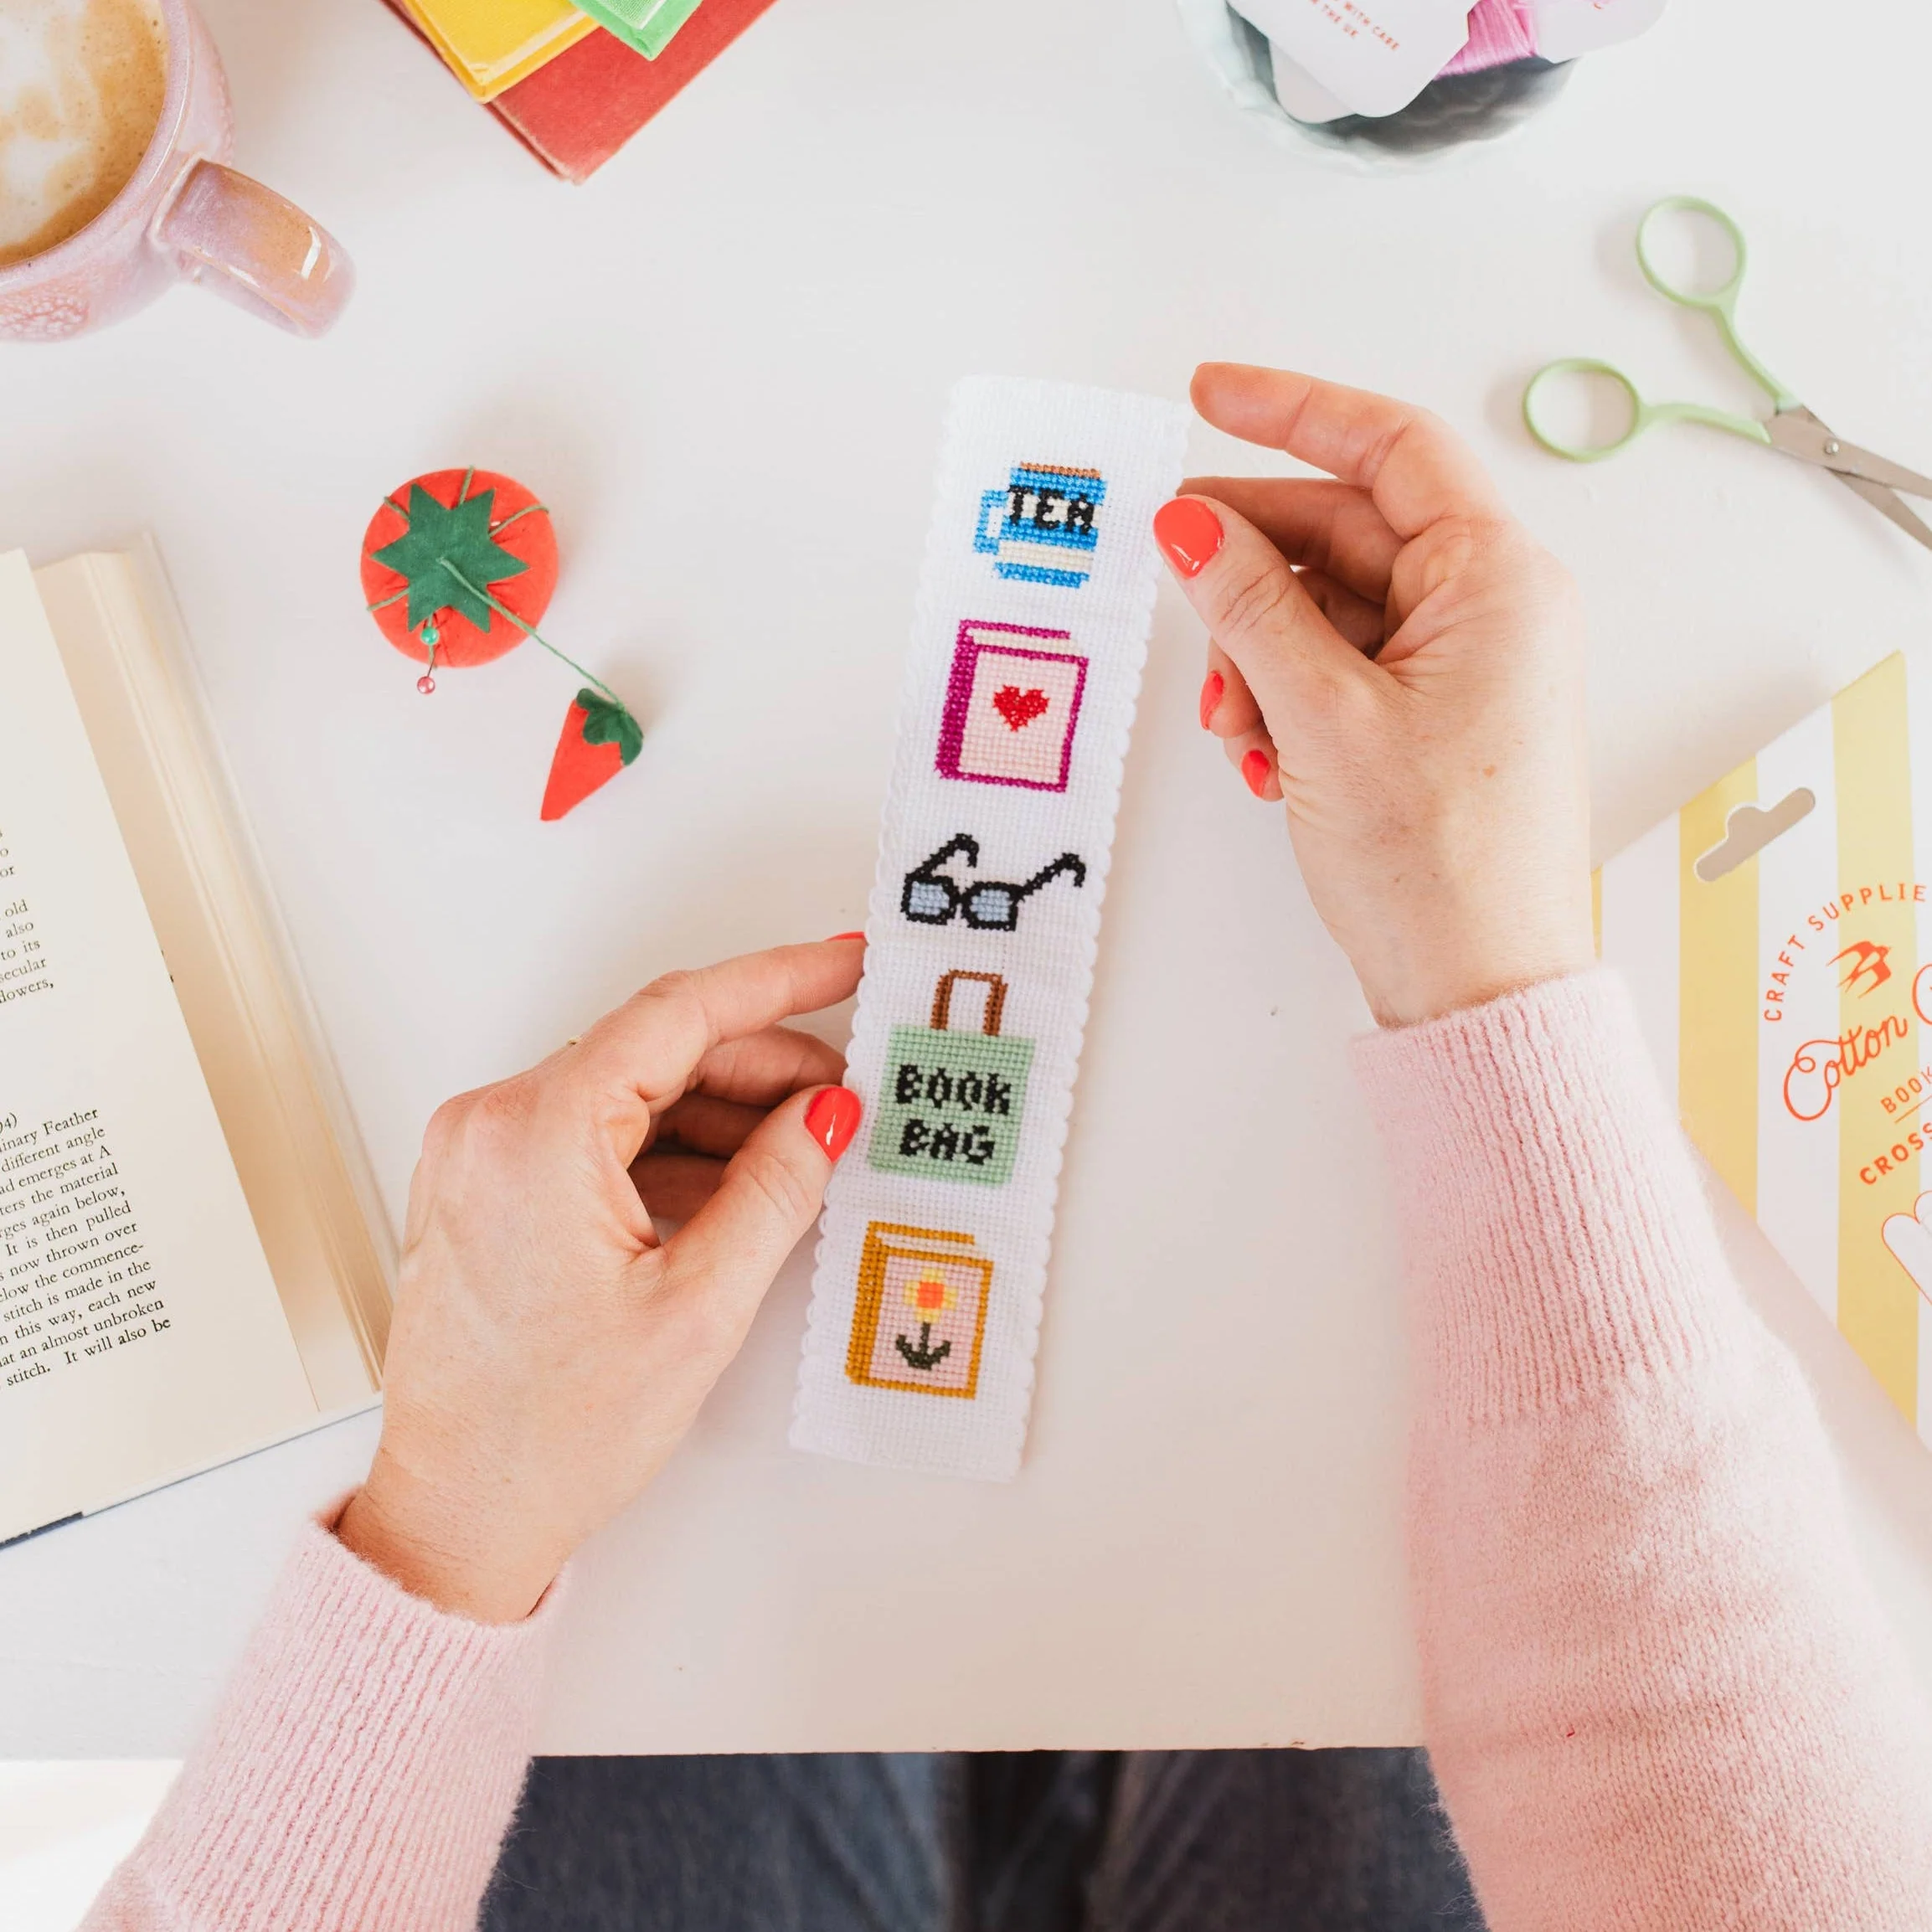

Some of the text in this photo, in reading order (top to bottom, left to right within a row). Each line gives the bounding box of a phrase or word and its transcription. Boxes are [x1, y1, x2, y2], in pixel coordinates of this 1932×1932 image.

[1007, 484, 1094, 534] TEA
[5, 899, 28, 917] old
[6, 922, 34, 939] also
[22, 940, 40, 953] its
[1764, 934, 1806, 1022] CRAFT
[895, 1064, 1012, 1116] BOOK
[1783, 1014, 1909, 1121] Cotton
[43, 1108, 99, 1136] Feather
[899, 1118, 995, 1166] BAG
[1, 1127, 106, 1172] different angle
[18, 1161, 77, 1188] emerges
[80, 1151, 95, 1166] at
[99, 1145, 111, 1159] A
[31, 1189, 54, 1203] the
[59, 1162, 119, 1194] material
[32, 1204, 70, 1227] again
[75, 1186, 126, 1210] below,
[6, 1200, 131, 1257] It is then pulled
[10, 1258, 40, 1277] now
[46, 1237, 100, 1264] thrown
[105, 1222, 138, 1241] over
[3, 1260, 152, 1322] stitch is made in the
[34, 1274, 59, 1289] the
[62, 1244, 144, 1279] commence-
[14, 1321, 42, 1340] this
[48, 1308, 83, 1327] way,
[87, 1291, 121, 1312] each
[126, 1280, 157, 1299] new
[19, 1345, 38, 1359] an
[41, 1324, 90, 1352] almost
[94, 1299, 165, 1333] unbroken
[6, 1318, 172, 1387] stitch. It will also be
